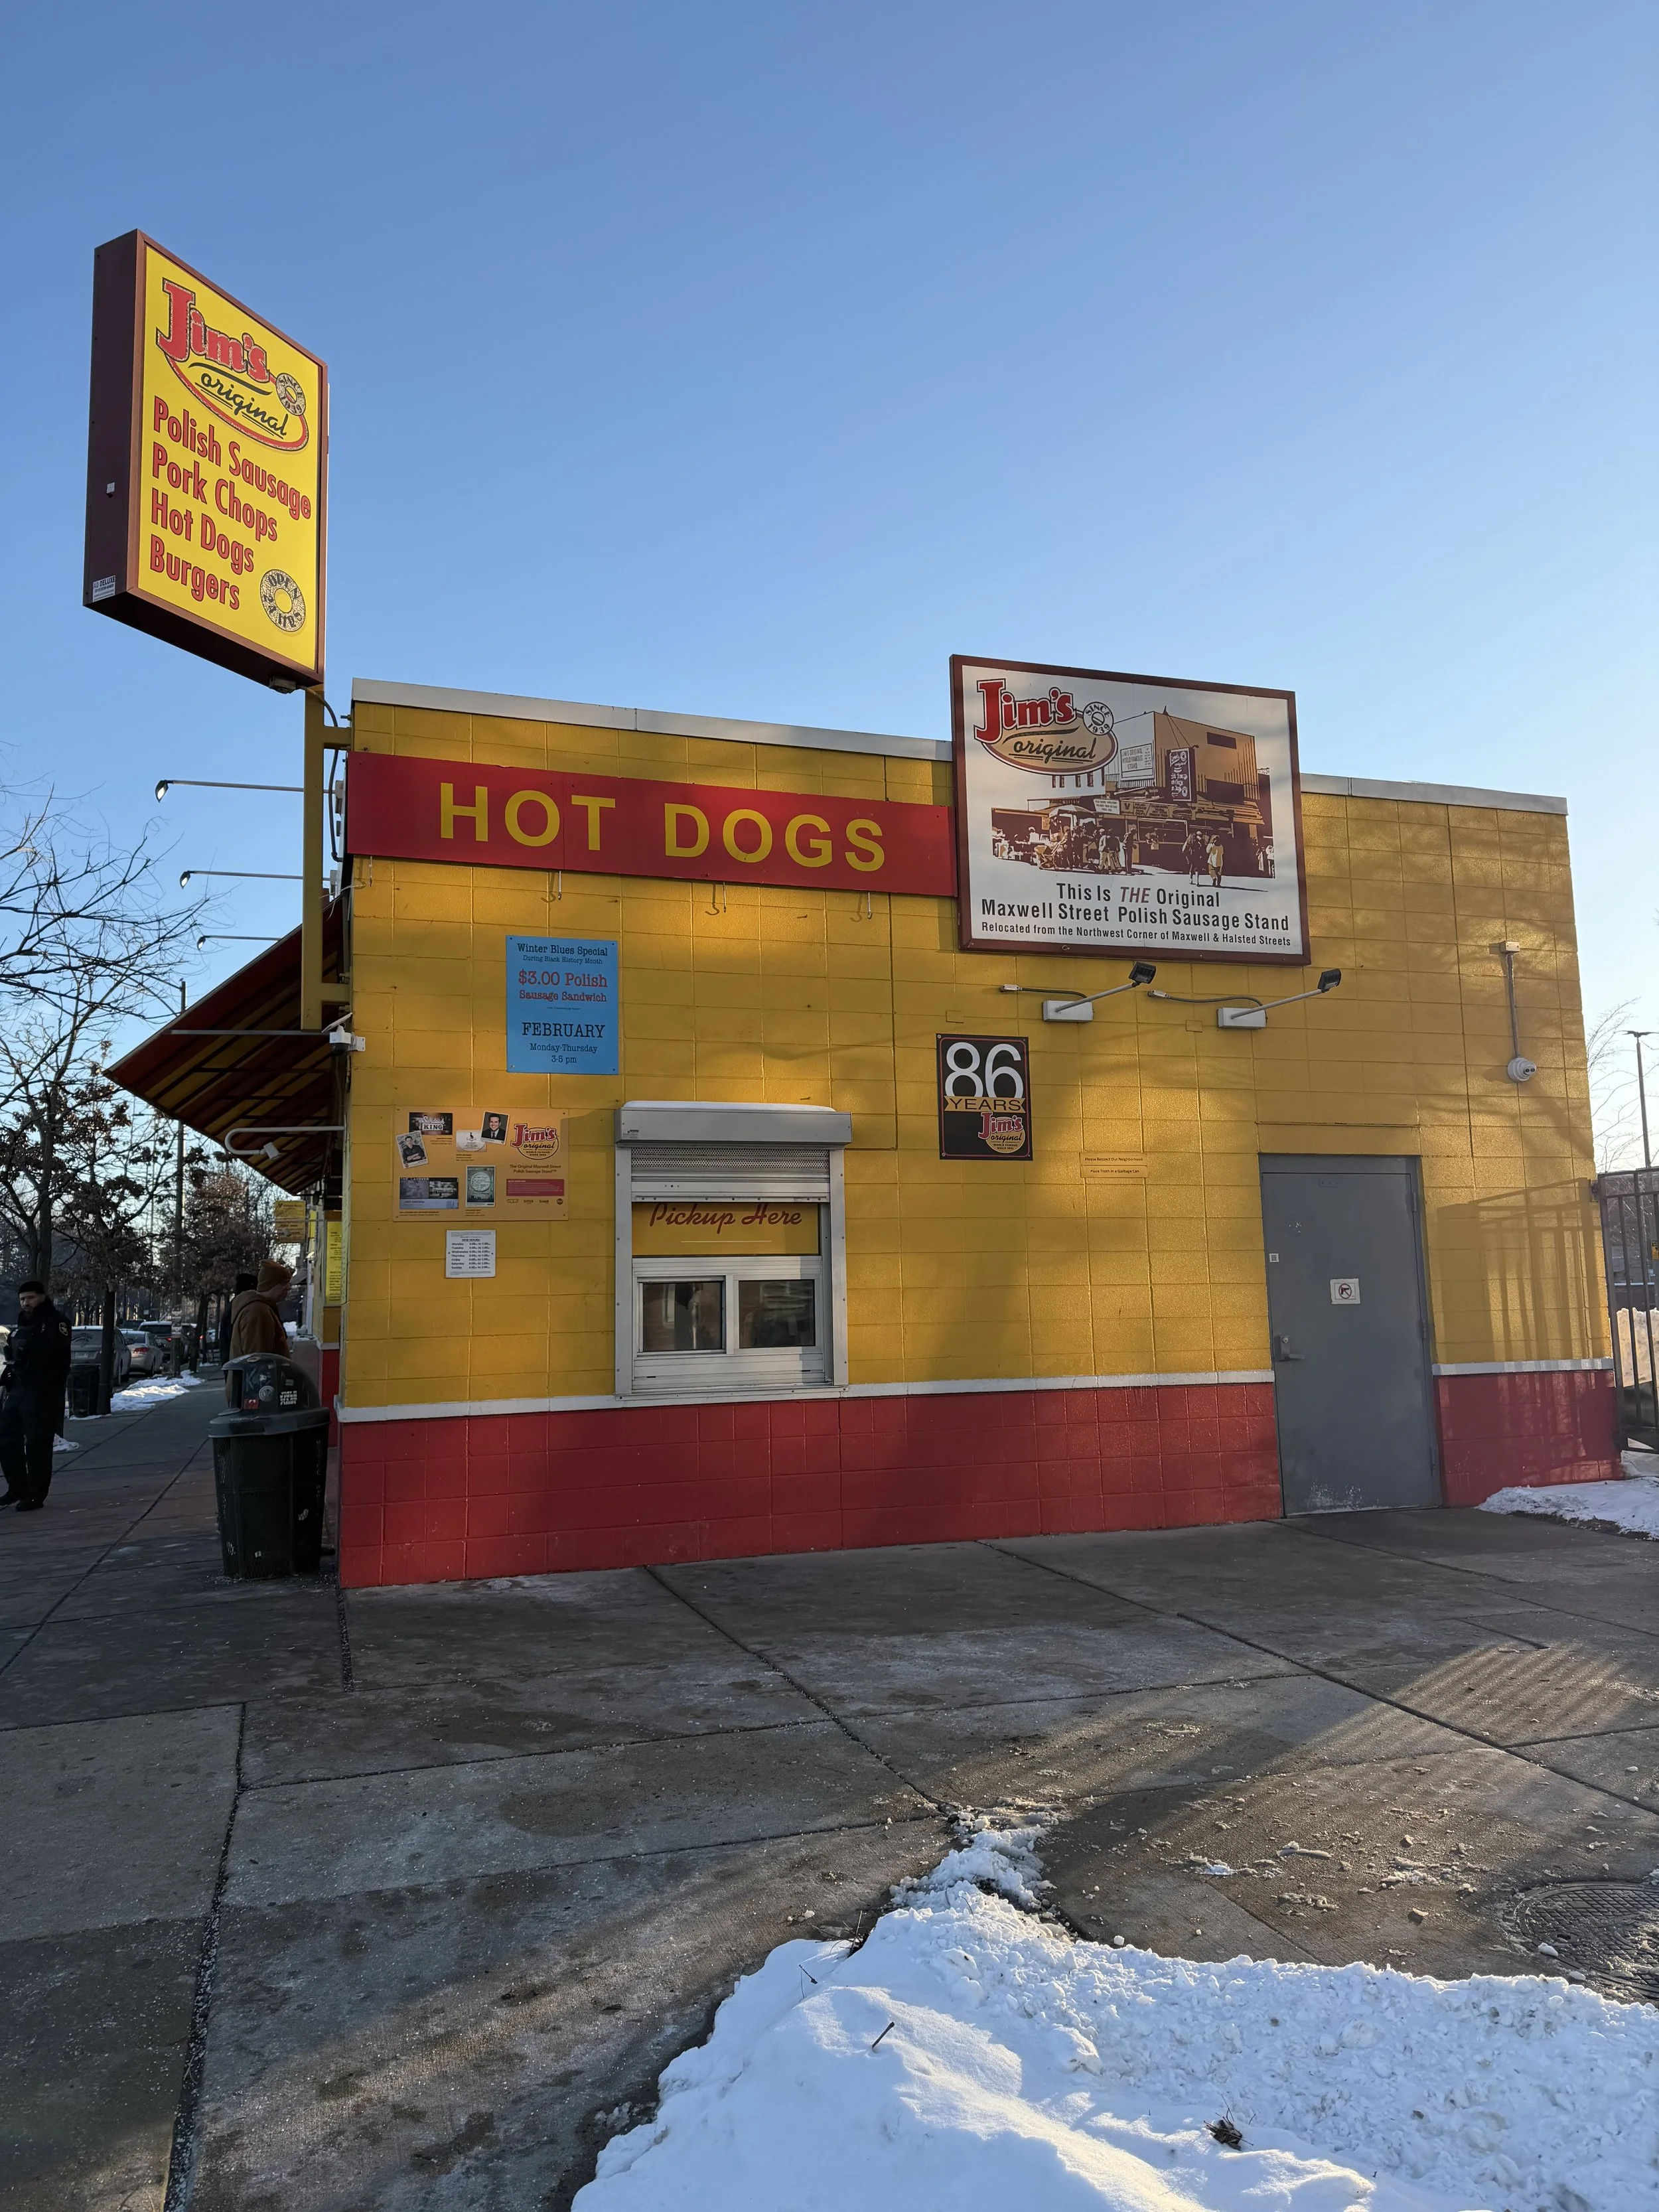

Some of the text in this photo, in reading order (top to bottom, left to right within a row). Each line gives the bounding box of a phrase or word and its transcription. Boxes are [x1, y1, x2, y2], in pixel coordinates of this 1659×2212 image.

[156, 277, 270, 383] Jim's
[279, 375, 303, 398] SINCE
[200, 372, 287, 436] original
[280, 396, 303, 413] 1939
[154, 394, 311, 521] Polish Sausage
[152, 441, 277, 542] Pork Chops
[151, 486, 254, 575] Hot Dogs
[149, 534, 240, 610] Burgers
[267, 573, 303, 600] OPEN
[974, 678, 1076, 744] Jim's
[1085, 704, 1111, 719] SINCE
[1087, 723, 1110, 733] 1939
[1013, 737, 1097, 764] original
[439, 782, 886, 872] HOT DOGS
[1056, 883, 1220, 909] This Is THE Original
[981, 899, 1289, 931] Maxwell Street Polish Sausage Stand
[981, 922, 1291, 946] Relocated from the Northwest Corner of Maxwell & Halsted Streets
[518, 943, 608, 957] Winter Blues Special
[518, 969, 608, 988] $3.00 Polish
[519, 990, 607, 1002] Sausage Sandwich
[522, 1022, 605, 1038] FEBRUARY
[530, 1043, 598, 1053] Monday-Thursday
[945, 1042, 1024, 1098] 86
[949, 1098, 1021, 1111] YEARS
[510, 1123, 557, 1148] Jim's
[978, 1112, 1024, 1140] Jim's
[990, 1131, 1022, 1143] original
[523, 1141, 555, 1151] original
[649, 1202, 802, 1234] Pickup Here
